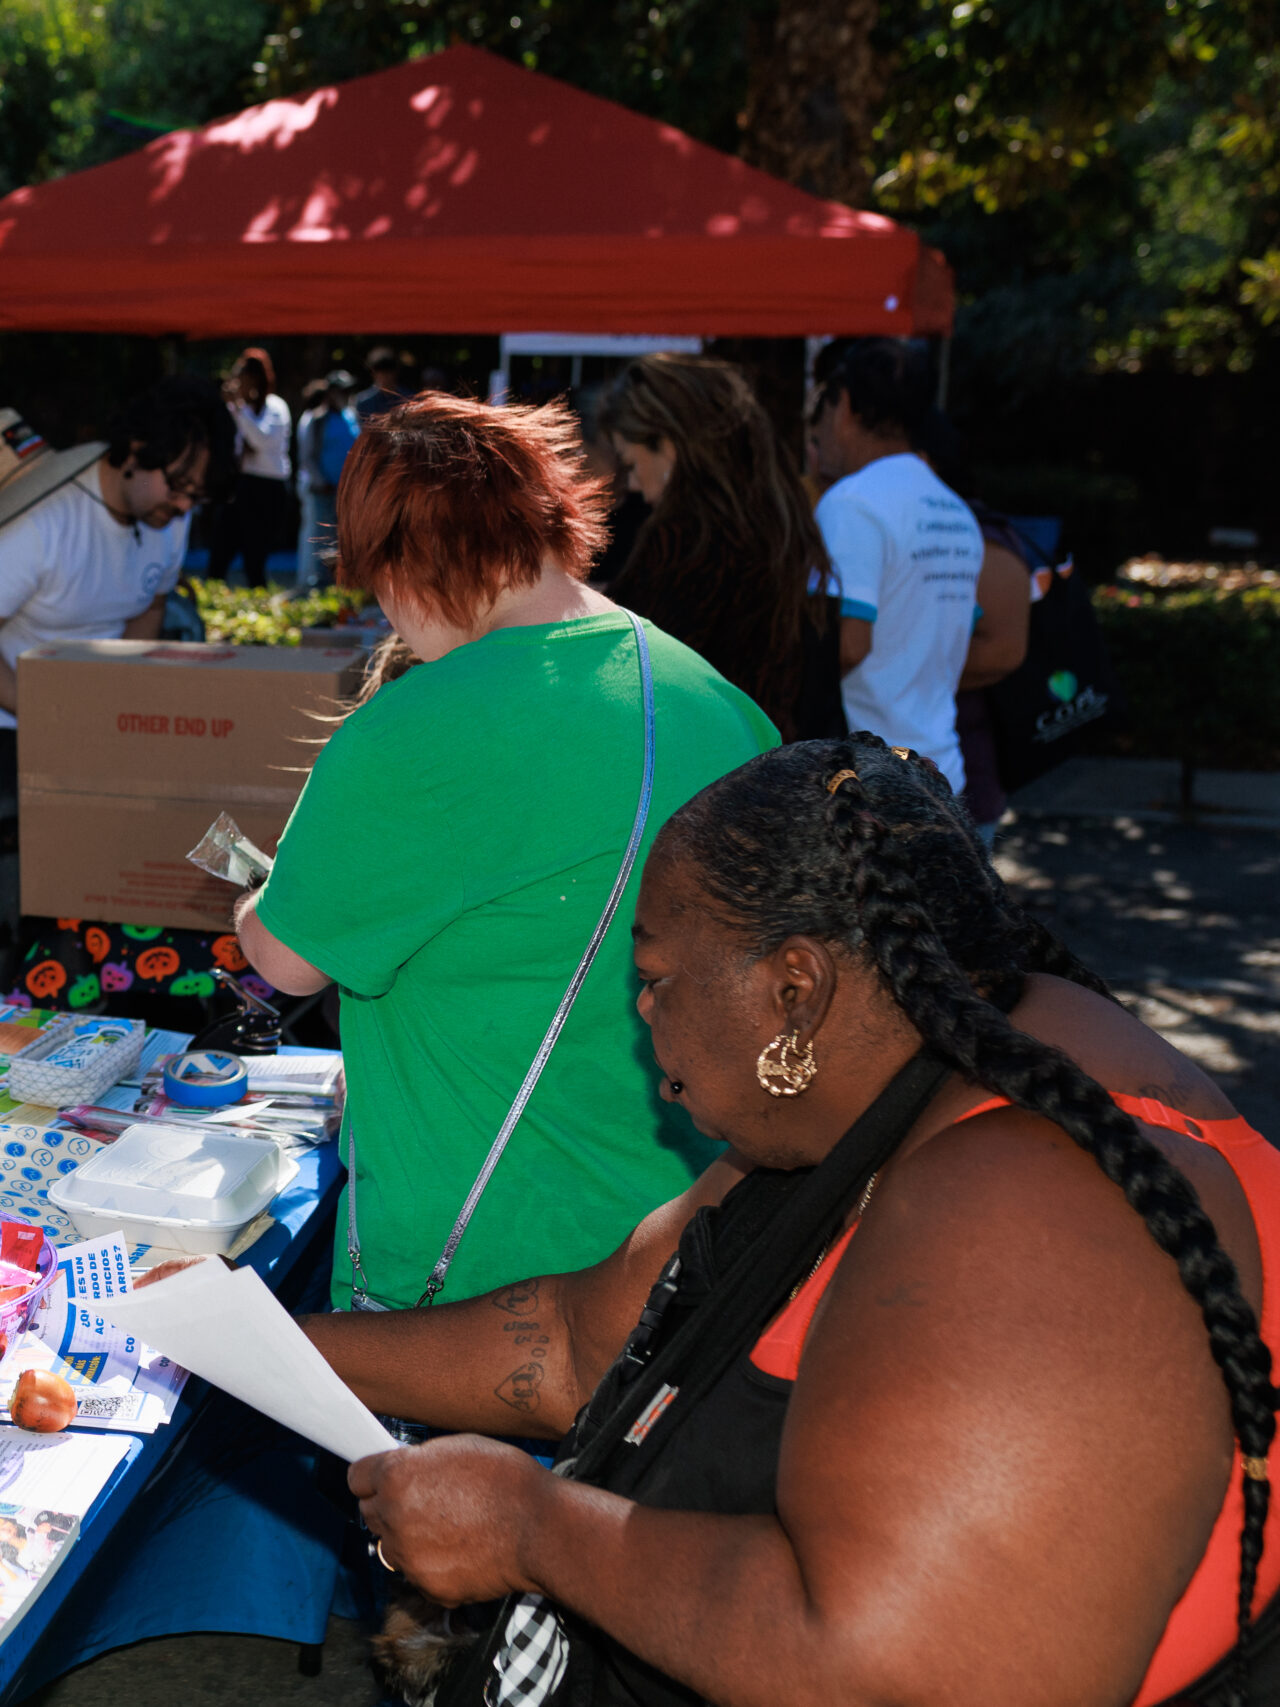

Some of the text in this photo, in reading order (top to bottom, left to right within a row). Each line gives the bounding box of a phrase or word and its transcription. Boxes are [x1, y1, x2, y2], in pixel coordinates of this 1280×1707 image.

[117, 713, 235, 738] OTHER END UP
[76, 1257, 84, 1274] UN
[88, 1253, 97, 1269] DE
[78, 1277, 87, 1294] ES
